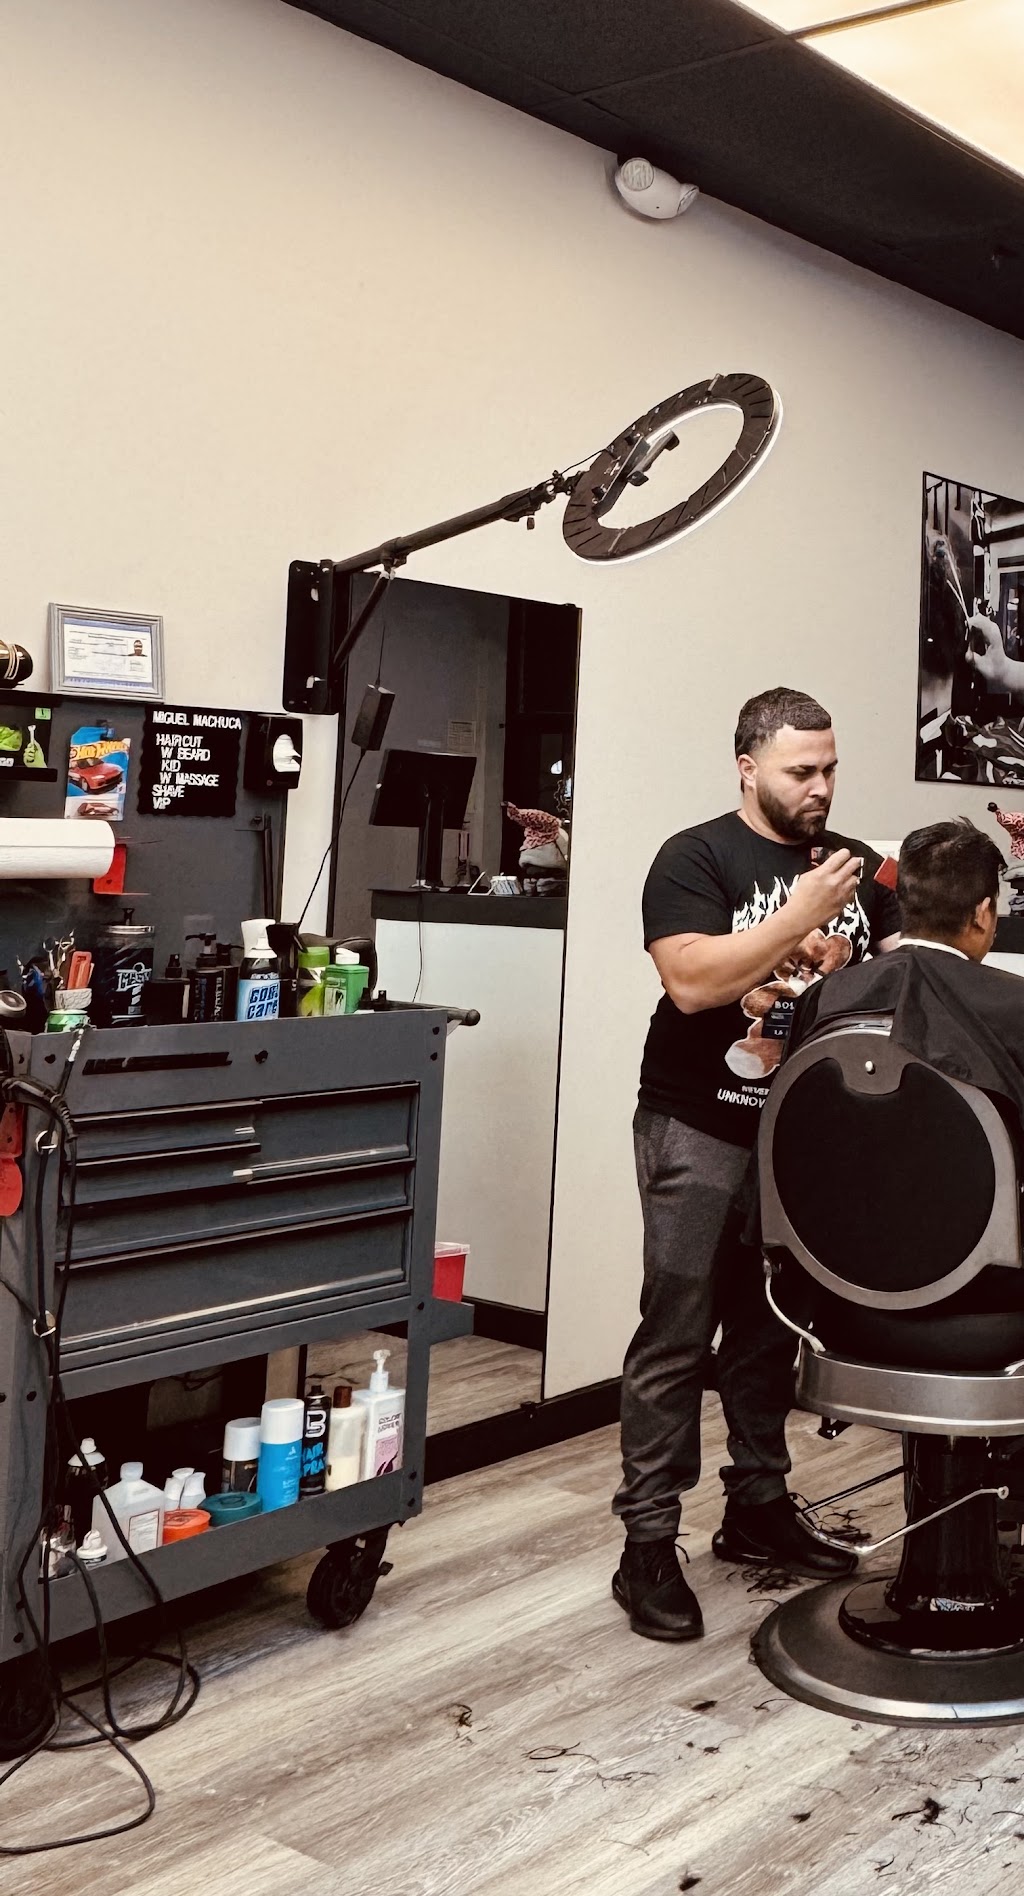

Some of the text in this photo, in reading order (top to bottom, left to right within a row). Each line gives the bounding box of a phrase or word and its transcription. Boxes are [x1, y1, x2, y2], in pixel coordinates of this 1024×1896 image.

[152, 711, 242, 730] MIGUEL MACHUCA
[156, 733, 203, 748] HAIRCUT
[161, 746, 211, 761] W BEARD
[161, 759, 181, 772] KID
[159, 771, 220, 787] W MASSAGE
[151, 784, 186, 797] SHAVE
[152, 797, 171, 809] VIP
